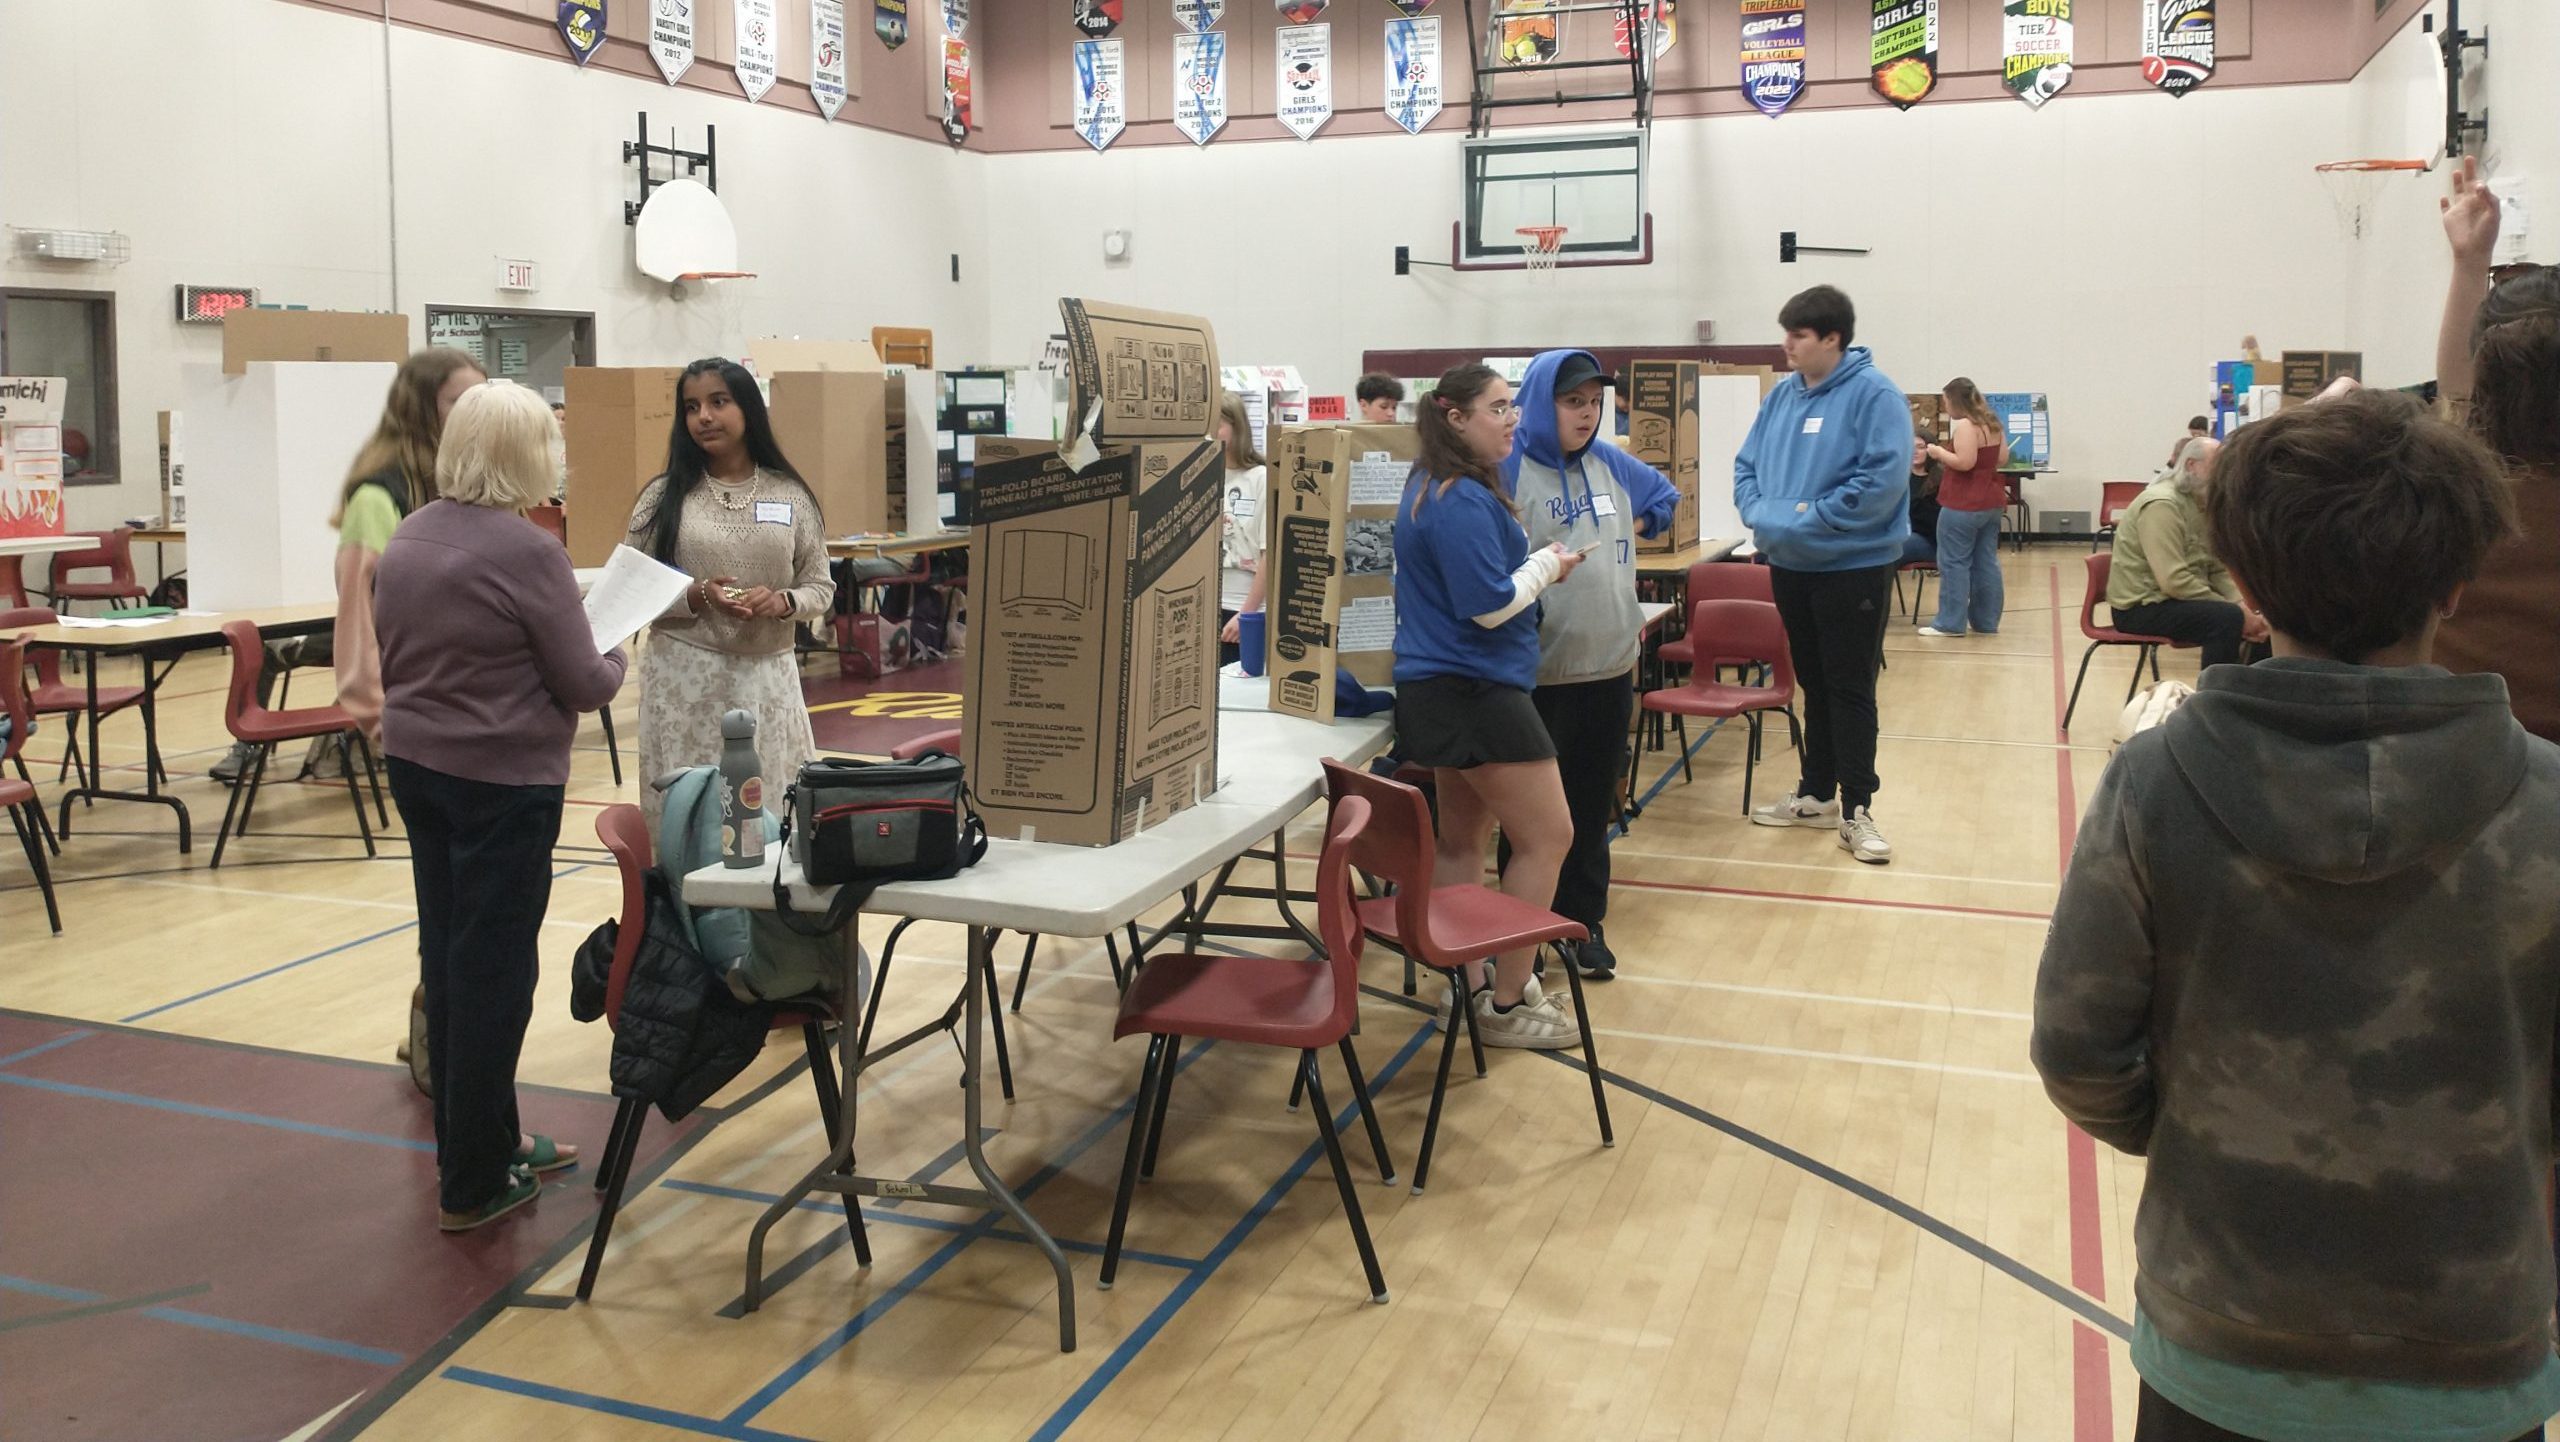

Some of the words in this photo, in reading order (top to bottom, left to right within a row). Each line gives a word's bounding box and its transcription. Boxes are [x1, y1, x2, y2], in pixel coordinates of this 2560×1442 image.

[1176, 1, 1220, 12] CHAMPIONS
[1745, 0, 1800, 12] TRIPLEBALL
[2026, 0, 2070, 20] BOYS
[1088, 16, 1109, 28] 2014
[1874, 1, 1924, 30] GIRLS
[656, 17, 677, 32] VARSITY
[1743, 14, 1803, 36] GIRLS
[2019, 24, 2045, 35] TIER
[2046, 16, 2057, 36] 2
[2146, 3, 2154, 53] TIER
[653, 30, 693, 50] CHAMPIONS
[1874, 22, 1924, 48] SOFTBALL
[2159, 31, 2214, 46] LEAGUE
[1744, 38, 1802, 49] VOLLEYBALL
[1874, 34, 1924, 60] CHAMPIONS
[2015, 39, 2061, 52] SOCCER
[664, 47, 682, 60] 2012
[1750, 49, 1796, 61] LEAGUE
[740, 59, 774, 76] CHAMPIONS
[1745, 61, 1801, 83] CHAMPIONS
[2005, 53, 2070, 80] CHAMPIONS
[748, 74, 764, 86] 2012
[1755, 83, 1792, 97] 2022
[1217, 98, 1222, 106] 2
[1293, 96, 1316, 105] GIRLS
[1390, 98, 1438, 109] CHAMPIONS
[1179, 109, 1222, 120] CHAMPIONS
[1282, 105, 1328, 116] CHAMPIONS
[1078, 116, 1121, 126] CHAMPIONS
[1295, 116, 1315, 126] 2016
[508, 265, 532, 287] EXIT
[448, 312, 471, 326] THE
[980, 479, 1029, 498] TRI-FOLD
[1030, 471, 1067, 488] BOARD
[979, 489, 1028, 508] PANNEAU
[1030, 486, 1045, 497] DE
[1063, 482, 1122, 503] WHITE/BLANC
[1045, 703, 1066, 711] MORE
[884, 1184, 913, 1194] School
